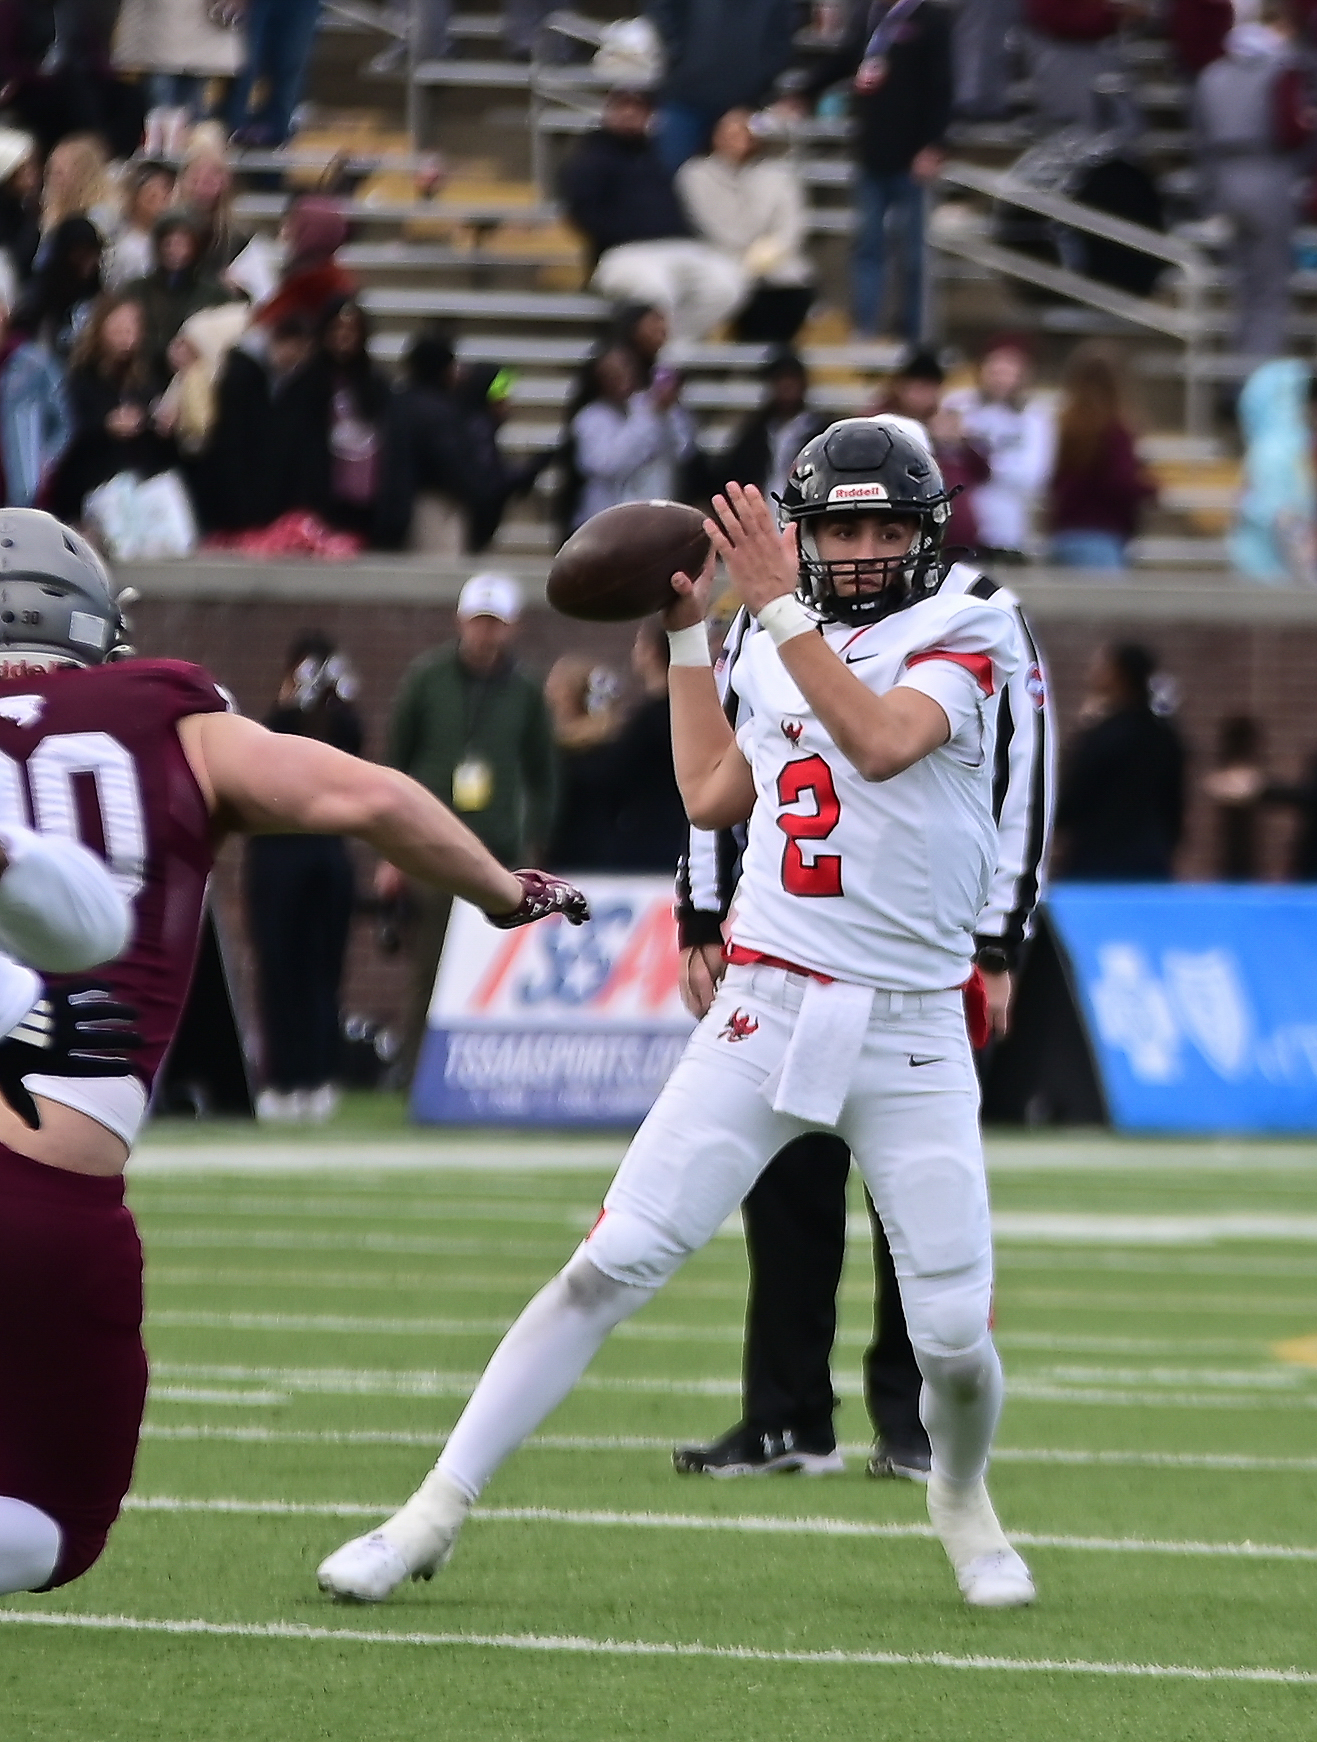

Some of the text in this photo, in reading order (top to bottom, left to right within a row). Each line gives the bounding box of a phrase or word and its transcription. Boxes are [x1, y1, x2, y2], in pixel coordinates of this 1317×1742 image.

[835, 487, 879, 498] Riddell
[21, 609, 40, 625] 30
[776, 753, 844, 897] 2
